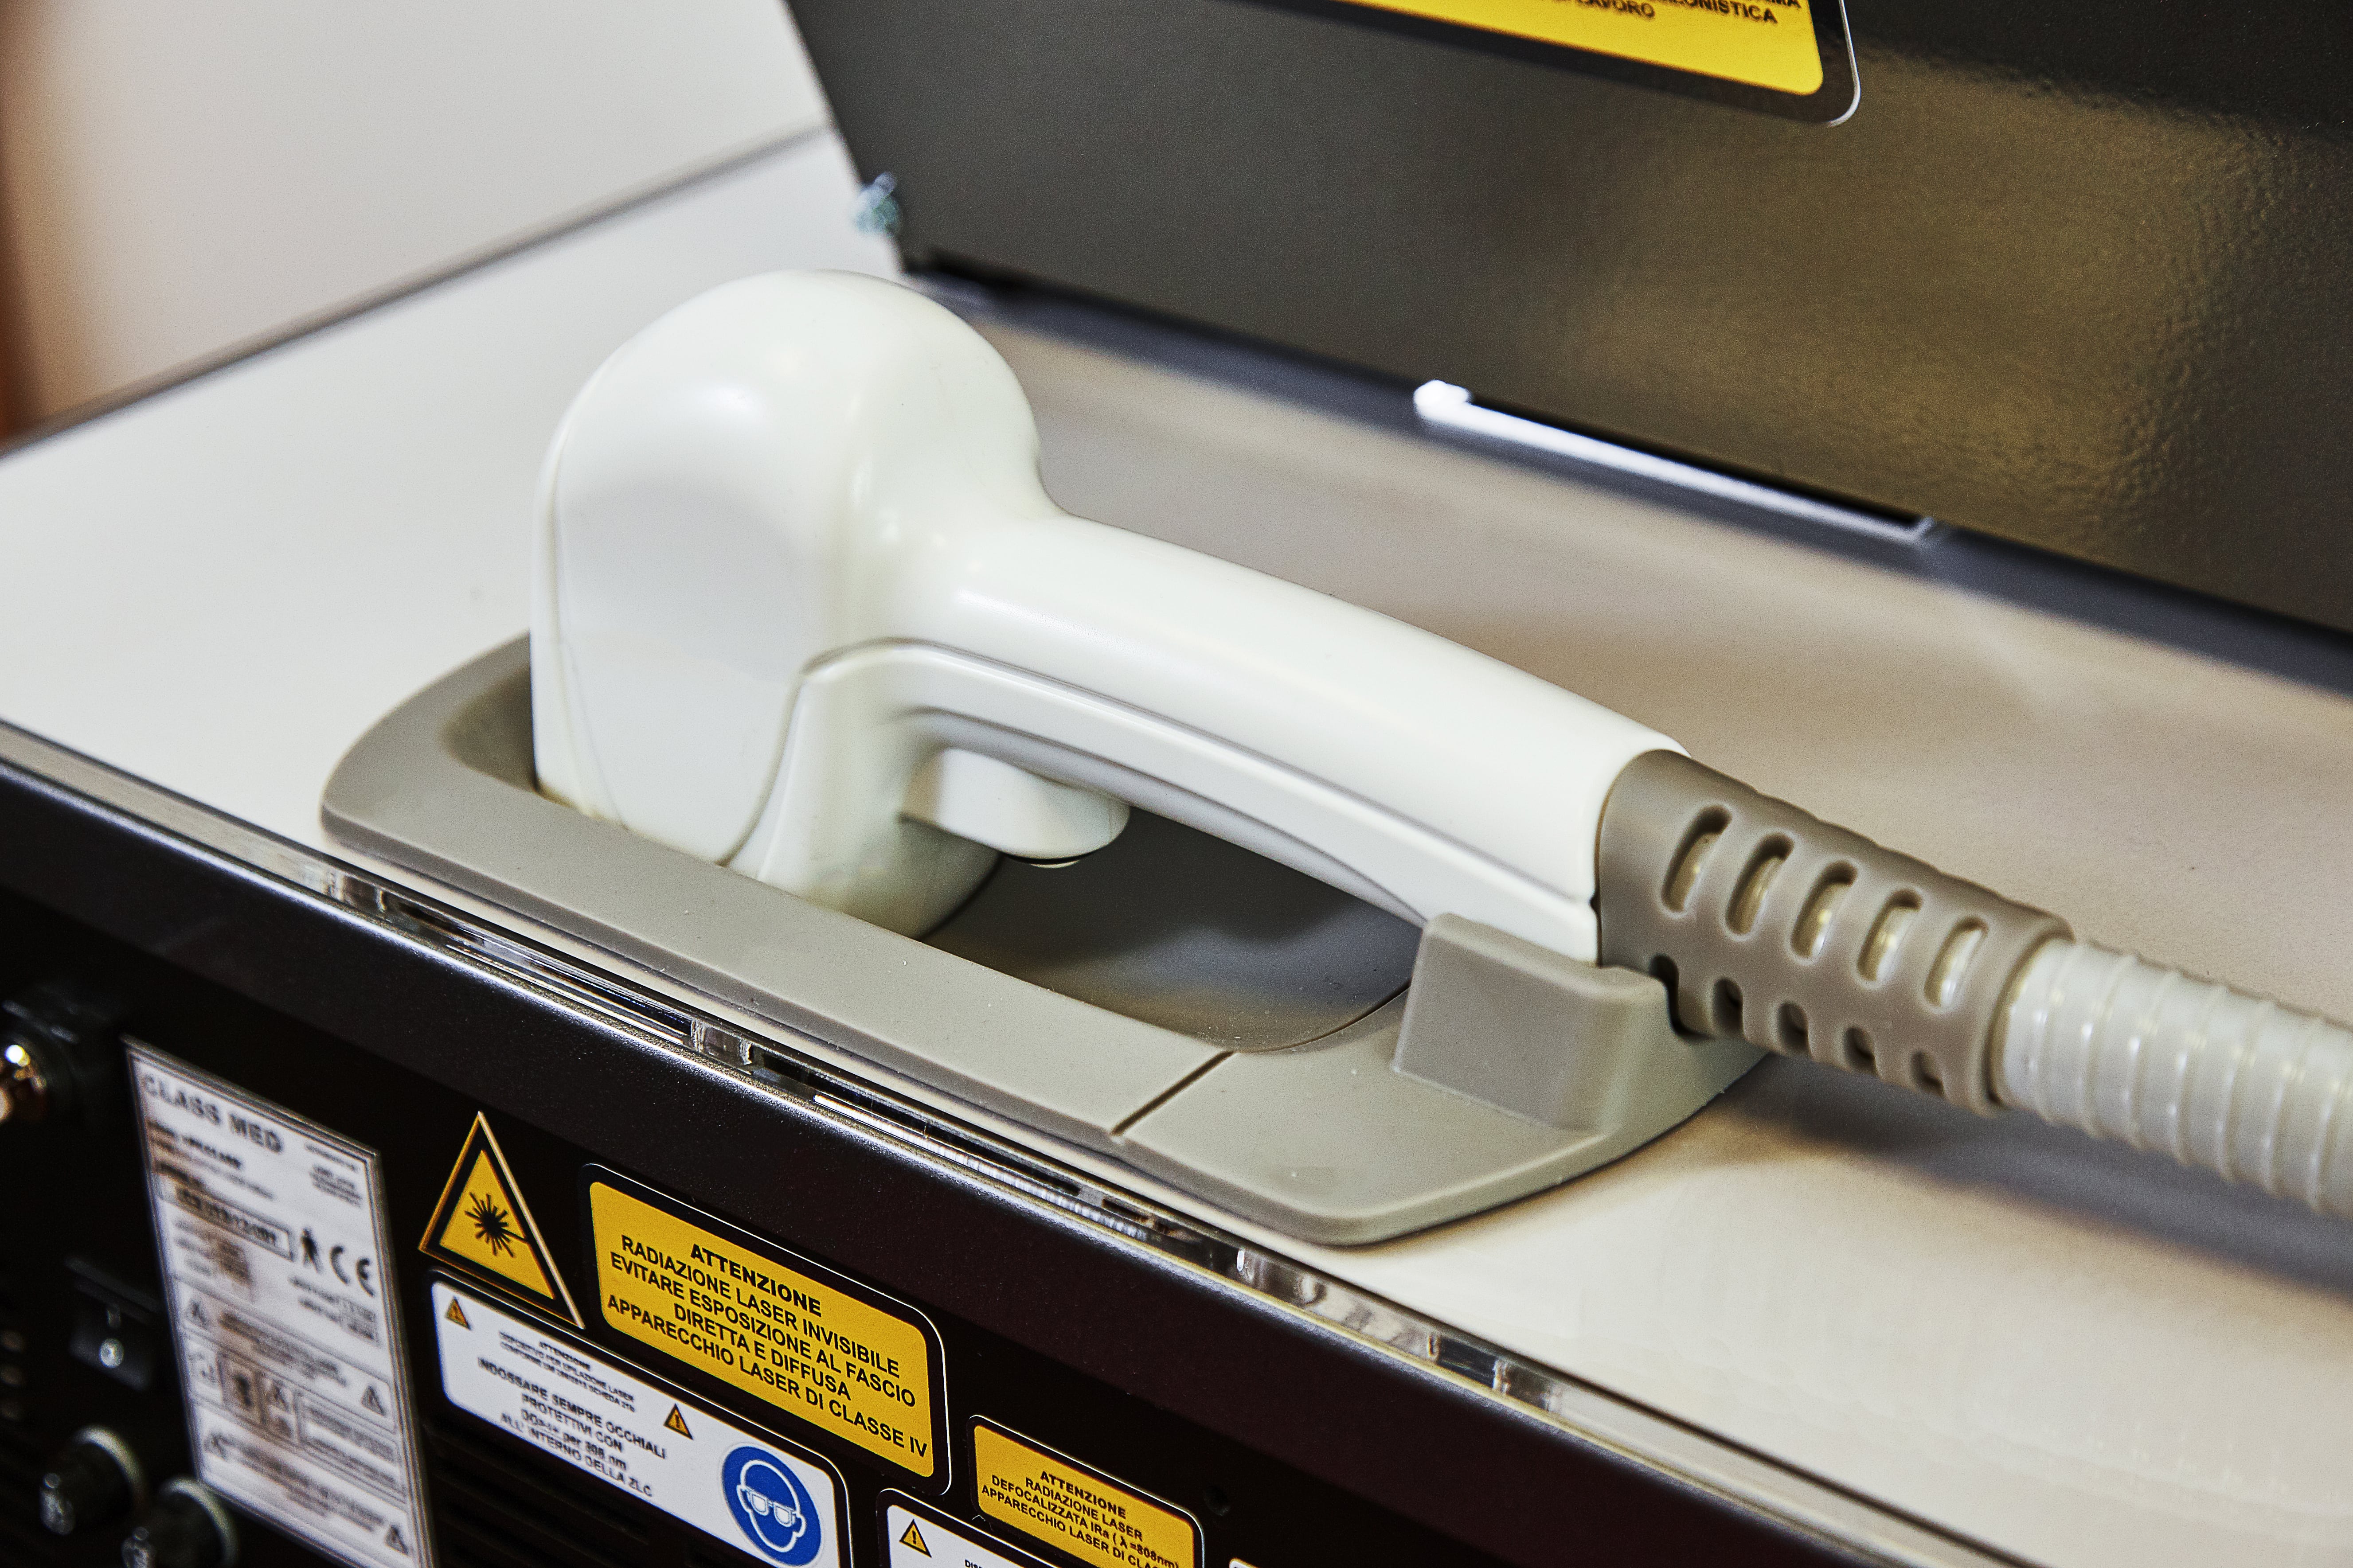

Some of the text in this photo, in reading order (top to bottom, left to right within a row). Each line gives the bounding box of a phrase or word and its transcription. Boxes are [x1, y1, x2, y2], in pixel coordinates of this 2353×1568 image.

[145, 1075, 221, 1125] CLASS
[228, 1112, 283, 1154] MED
[621, 1234, 900, 1379] RADIAZIONE LASER INVISIBILE
[690, 1244, 822, 1317] ATTENZIONE
[539, 1341, 590, 1371] ATTENZIONE
[610, 1252, 915, 1408] EVITARE ESPOSIZIONE AL FASCIO
[674, 1303, 851, 1400] DIRETTA E DIFFUSA
[477, 1357, 666, 1459] INDOSSARE SEMPRE OCCHIALI
[608, 1295, 927, 1458] APPARECCHIO LASER DI CLASSE IV
[608, 1384, 635, 1402] LASER
[521, 1393, 622, 1453] PROTETTIVI CON
[528, 1425, 582, 1460] INTERNO
[585, 1455, 625, 1484] DELLA
[629, 1476, 653, 1497] ZLC
[609, 1455, 627, 1470] nm
[1040, 1470, 1126, 1519] ATTENZIONE
[981, 1485, 1066, 1532] APPARECCHIO
[1069, 1526, 1110, 1554] LASER
[1112, 1546, 1125, 1561] DI
[992, 1474, 1088, 1529] DEFOCALIZZATA
[1091, 1521, 1110, 1539] IRa
[1025, 1477, 1142, 1542] RADIAZIONE LASER
